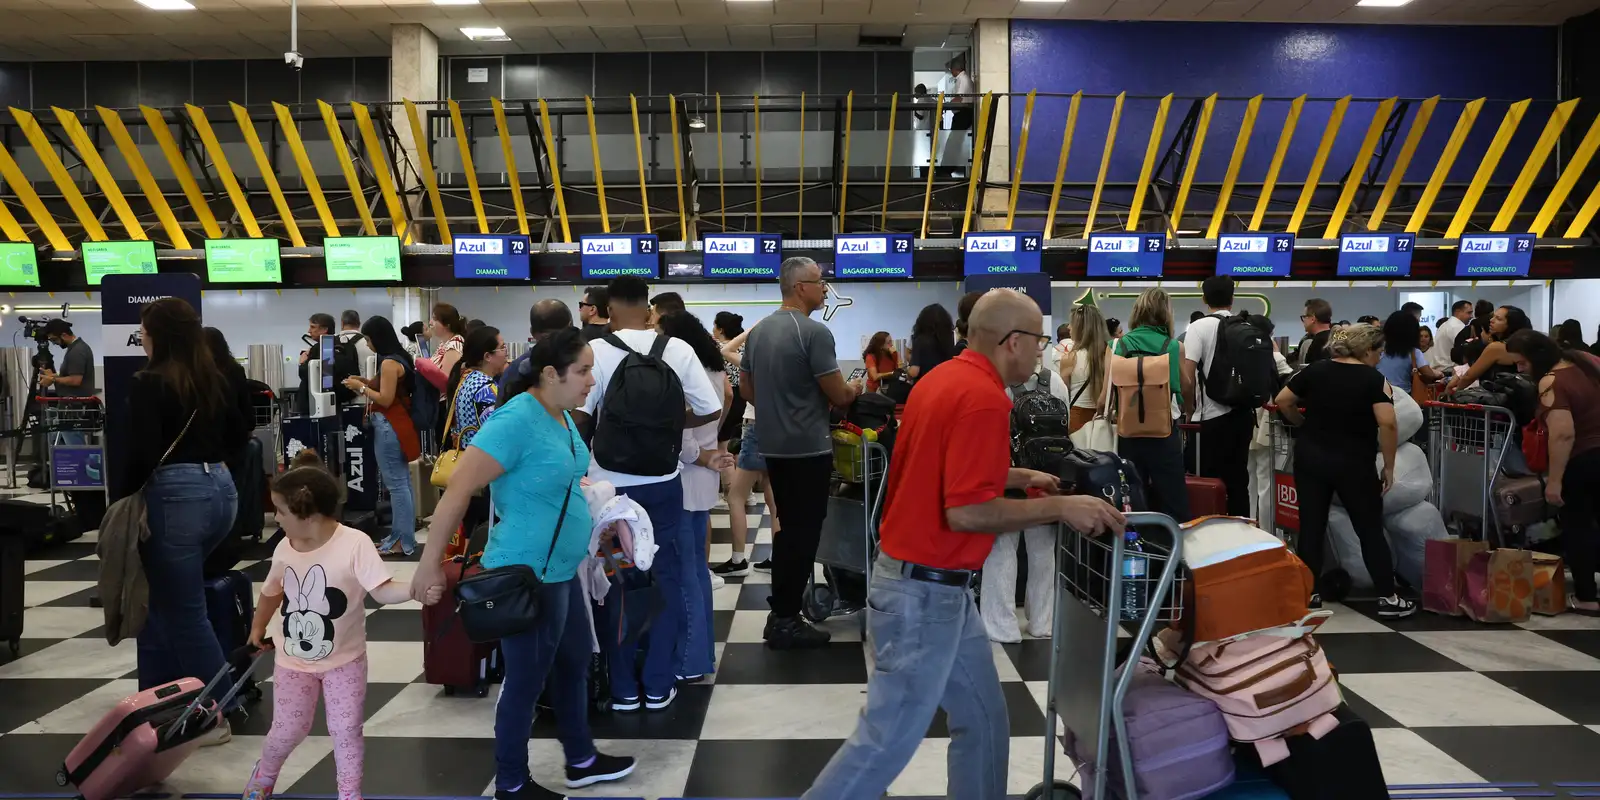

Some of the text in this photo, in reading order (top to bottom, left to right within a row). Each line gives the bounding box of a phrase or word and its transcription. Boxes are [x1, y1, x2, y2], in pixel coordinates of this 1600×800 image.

[459, 241, 485, 252] Azul
[511, 241, 524, 250] 70
[587, 241, 614, 252] Azul
[640, 240, 652, 250] 71
[709, 240, 737, 251] Azul
[763, 240, 776, 249] 72
[841, 240, 869, 251] Azul
[895, 240, 908, 249] 73
[970, 239, 998, 250] Azul
[1024, 238, 1037, 247] 74
[1094, 239, 1122, 250] Azul
[1148, 239, 1160, 248] 75
[1223, 239, 1251, 250] Azul
[1277, 239, 1289, 248] 76
[1345, 239, 1373, 250] Azul
[1397, 238, 1410, 248] 77
[1464, 240, 1493, 251] Azul
[1517, 239, 1530, 248] 78
[346, 447, 364, 493] Azul
